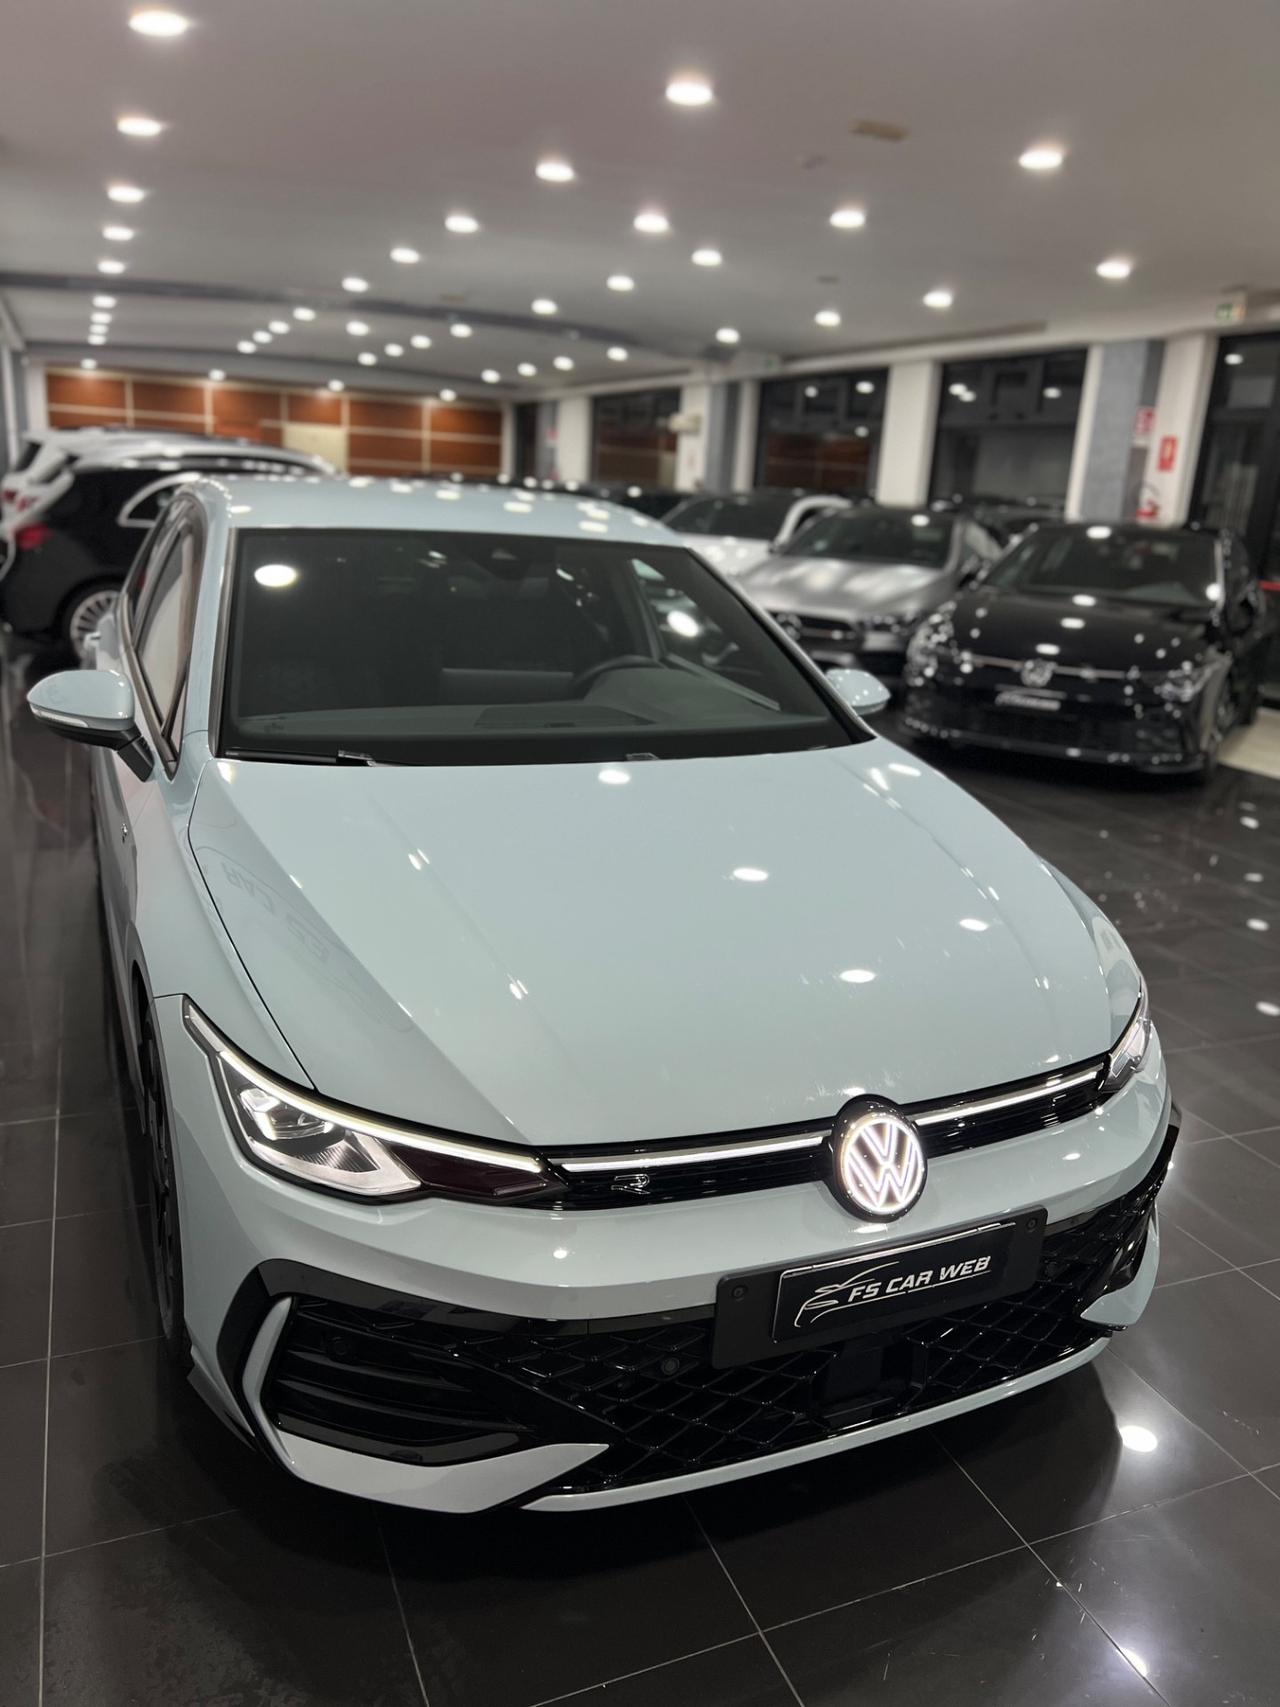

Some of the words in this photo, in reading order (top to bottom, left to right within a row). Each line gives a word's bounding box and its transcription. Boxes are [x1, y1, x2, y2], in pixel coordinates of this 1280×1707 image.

[845, 1117, 924, 1213] VW
[847, 1283, 880, 1302] FS
[886, 1270, 932, 1294] CAR
[939, 1255, 991, 1281] WEB
